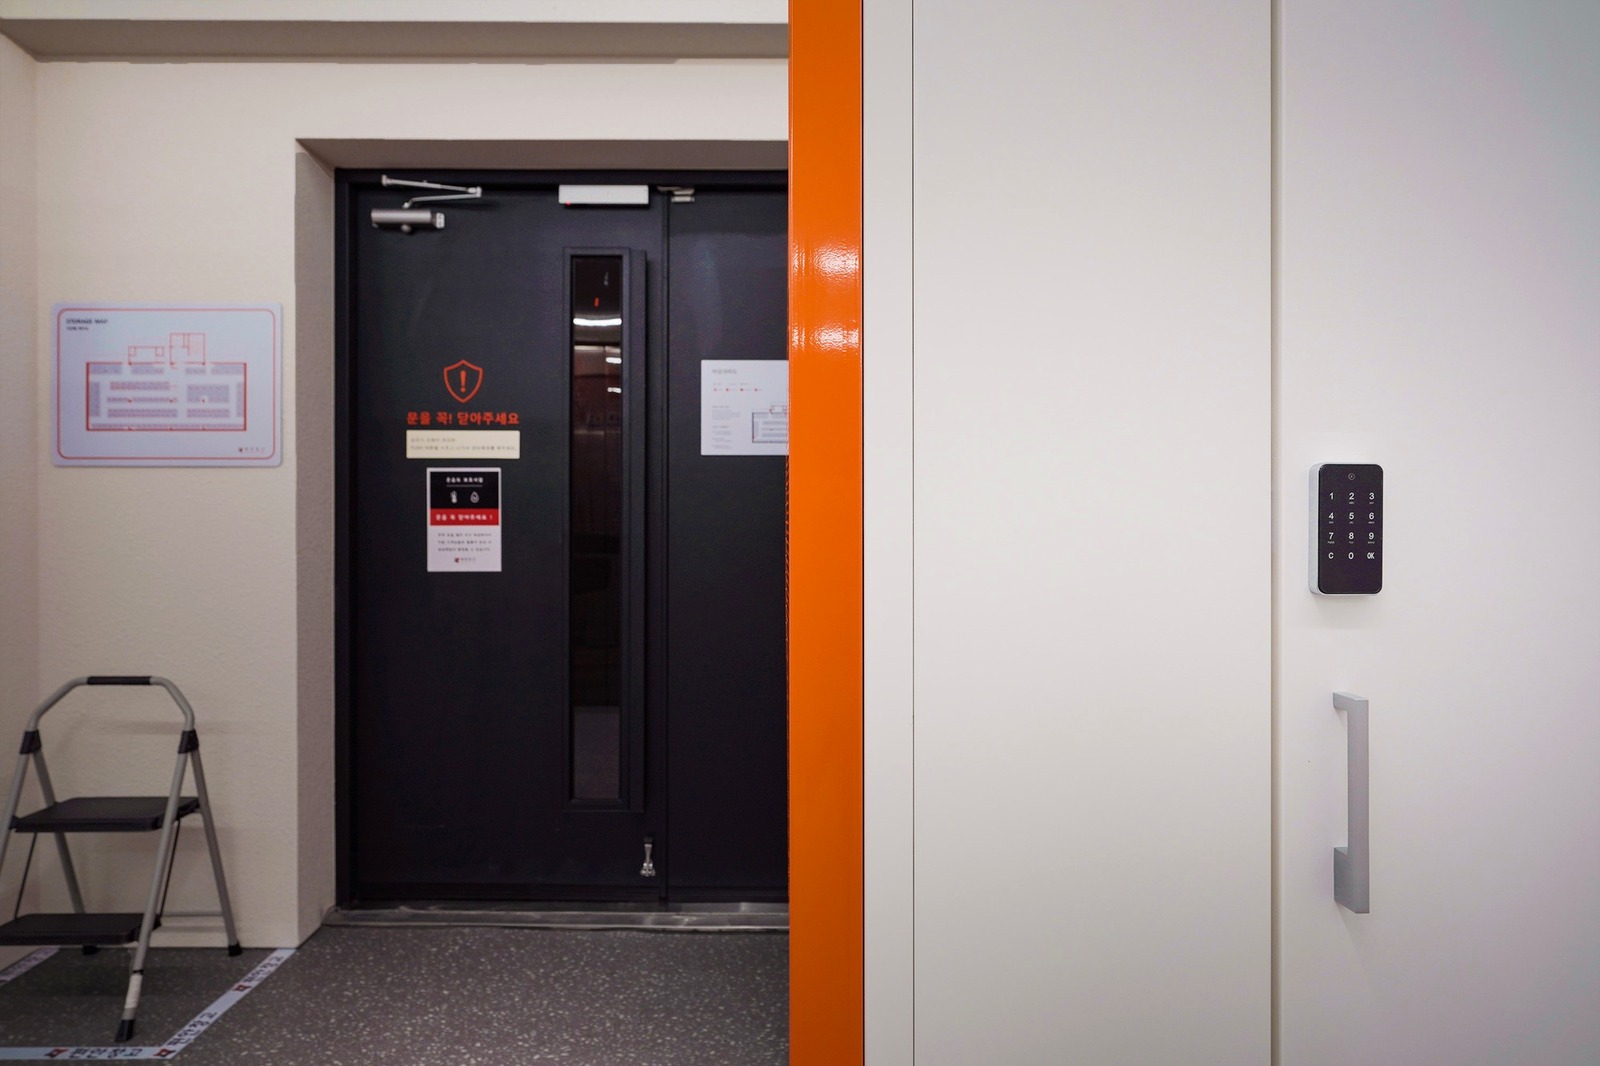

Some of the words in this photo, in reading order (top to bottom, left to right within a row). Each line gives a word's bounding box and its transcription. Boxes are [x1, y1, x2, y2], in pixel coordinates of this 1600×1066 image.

[407, 411, 431, 426] 문을
[436, 411, 453, 425] 꼭!
[457, 411, 519, 426] 닫아주세요
